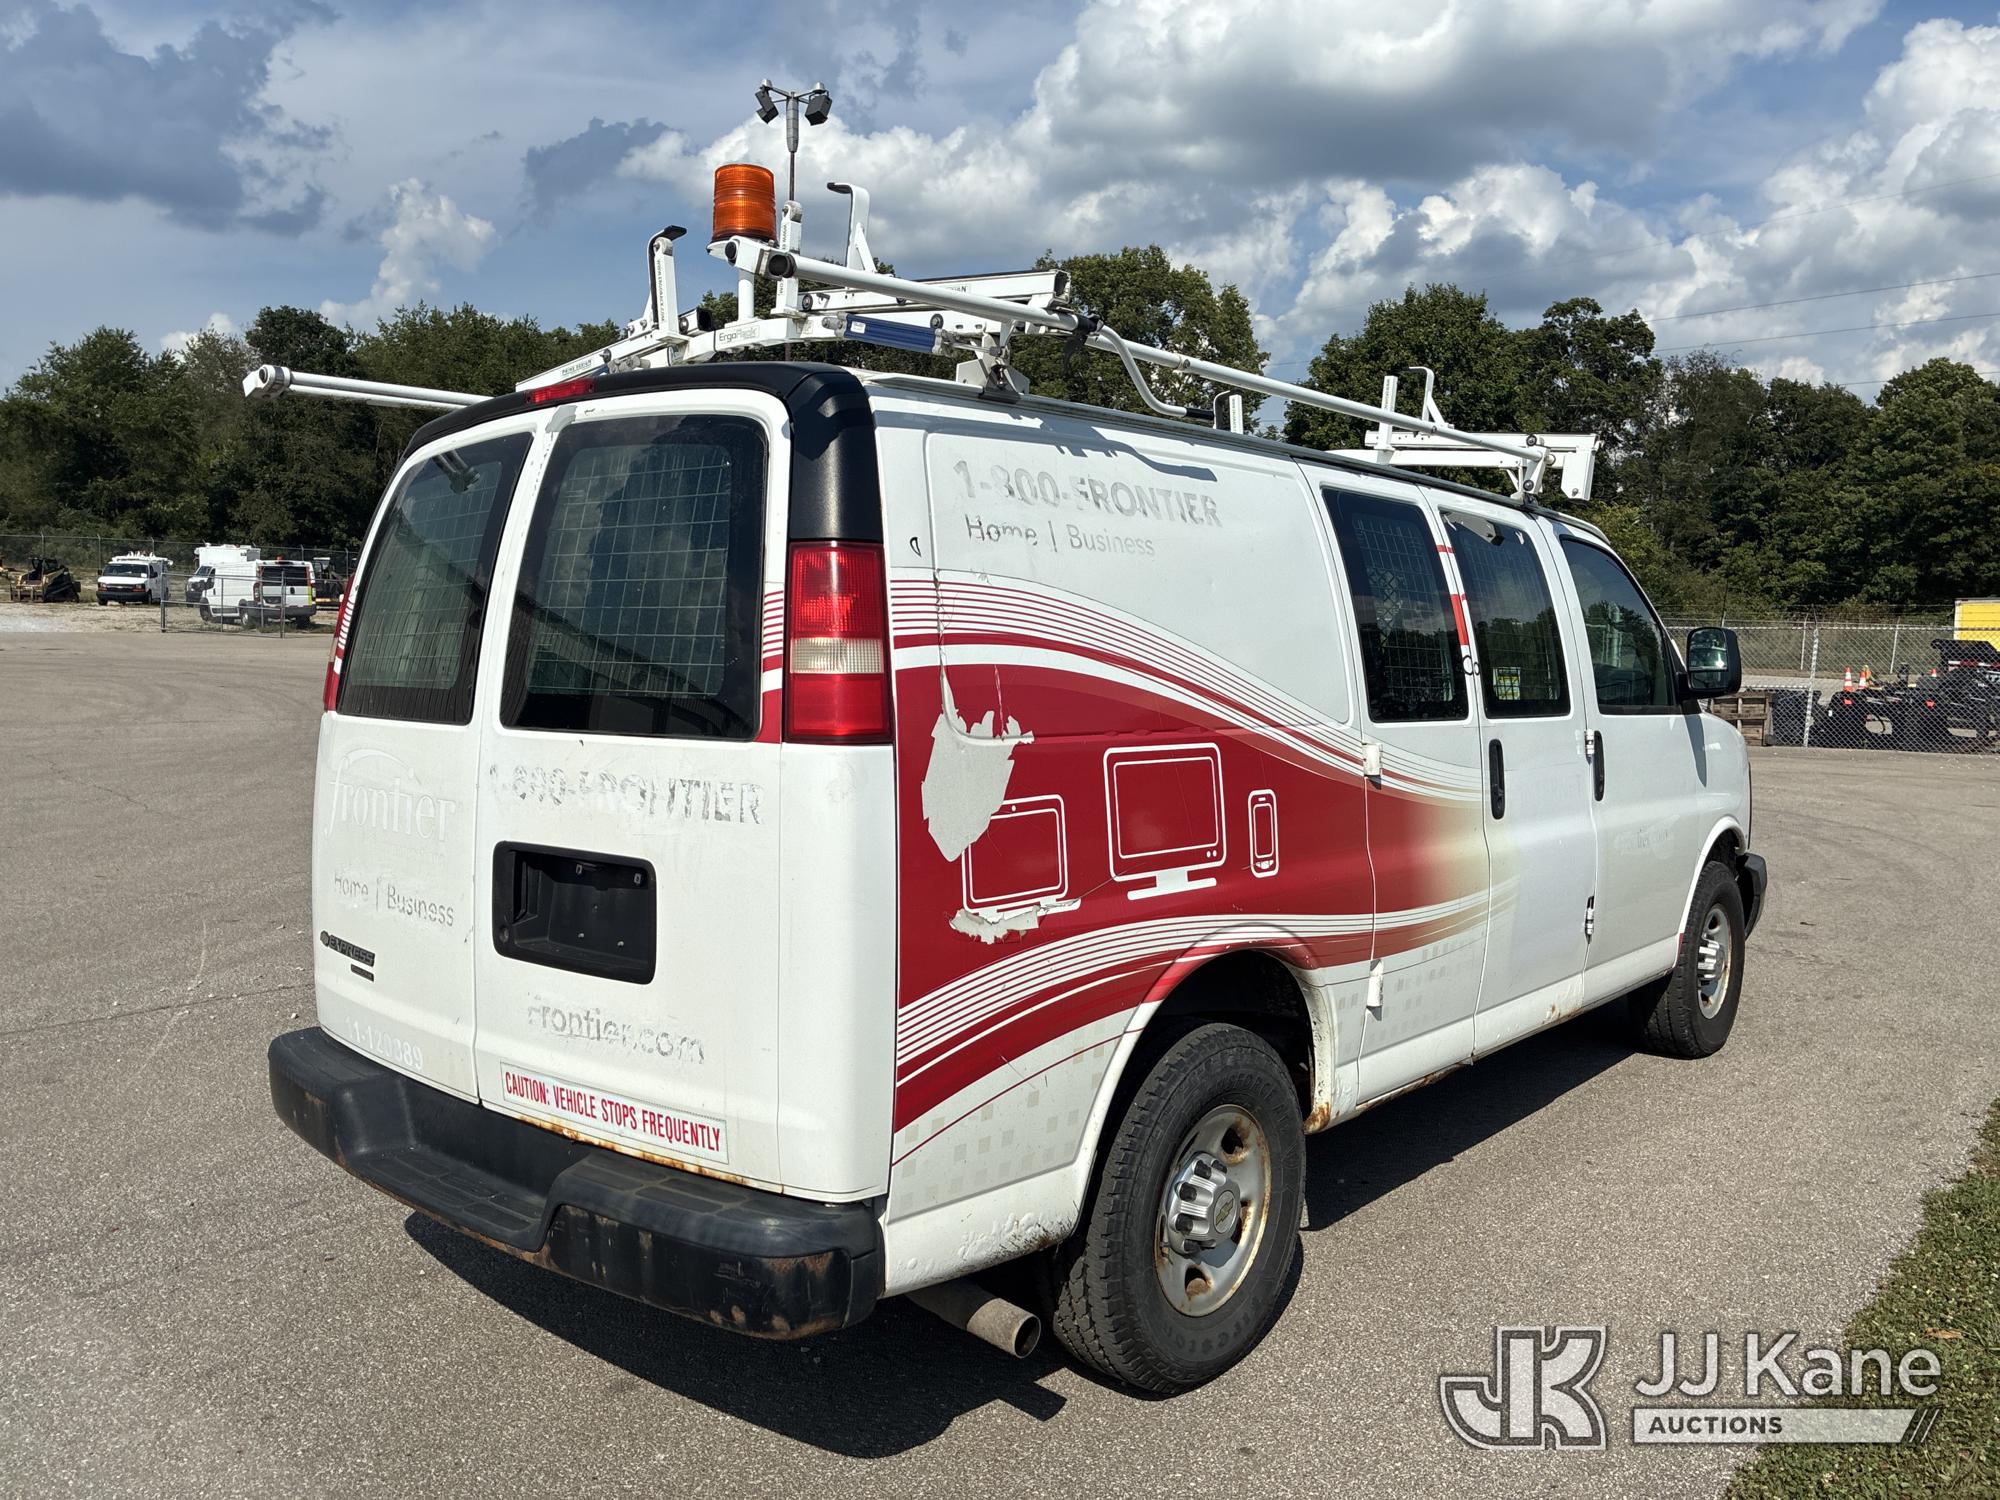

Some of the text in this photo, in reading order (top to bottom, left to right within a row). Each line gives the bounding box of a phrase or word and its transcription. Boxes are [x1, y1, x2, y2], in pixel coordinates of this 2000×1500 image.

[965, 513, 1156, 556] Home Business
[387, 883, 454, 927] Business
[329, 934, 376, 967] EXPRESS
[504, 1071, 721, 1152] CAUTION: VEHICLE STOPS FREQUENTLY
